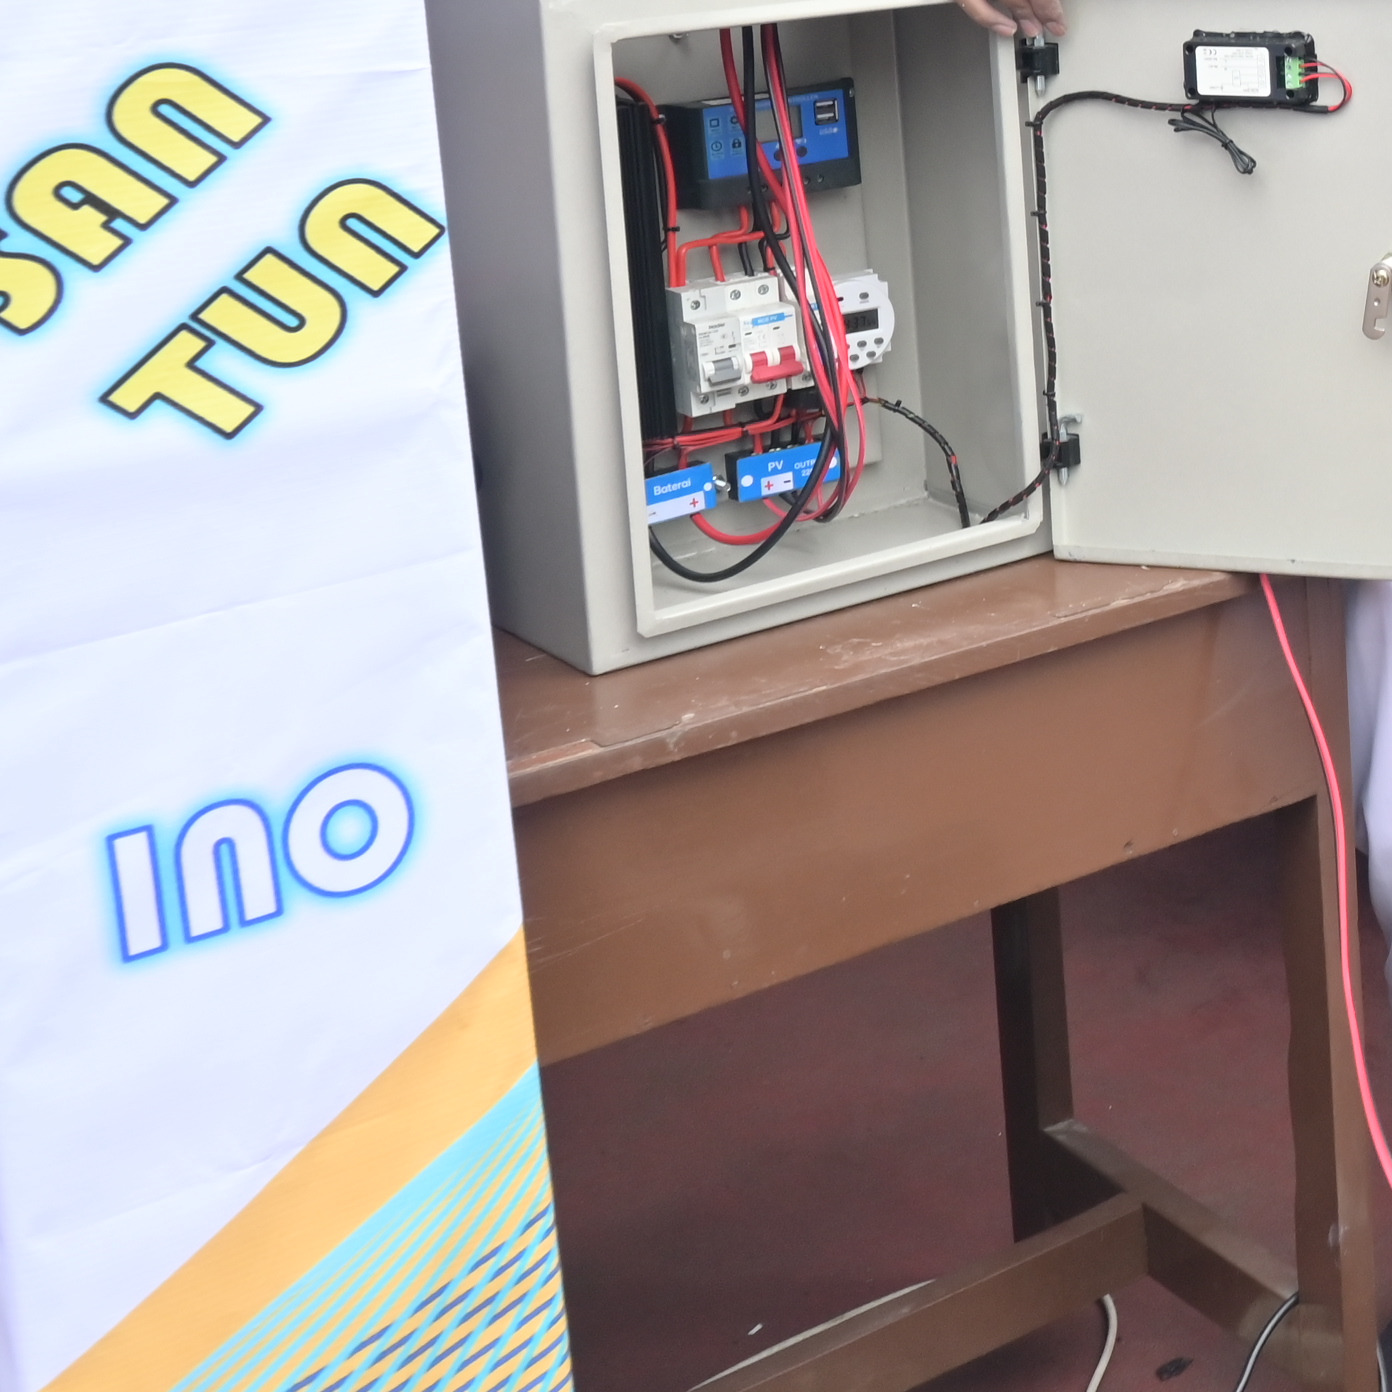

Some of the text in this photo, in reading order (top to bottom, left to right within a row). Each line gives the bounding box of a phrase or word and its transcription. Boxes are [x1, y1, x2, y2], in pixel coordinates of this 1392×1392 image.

[99, 177, 446, 440] TUN
[768, 459, 784, 472] PV
[794, 458, 817, 470] OUTP
[653, 477, 692, 496] Baterai
[106, 760, 416, 965] INO
